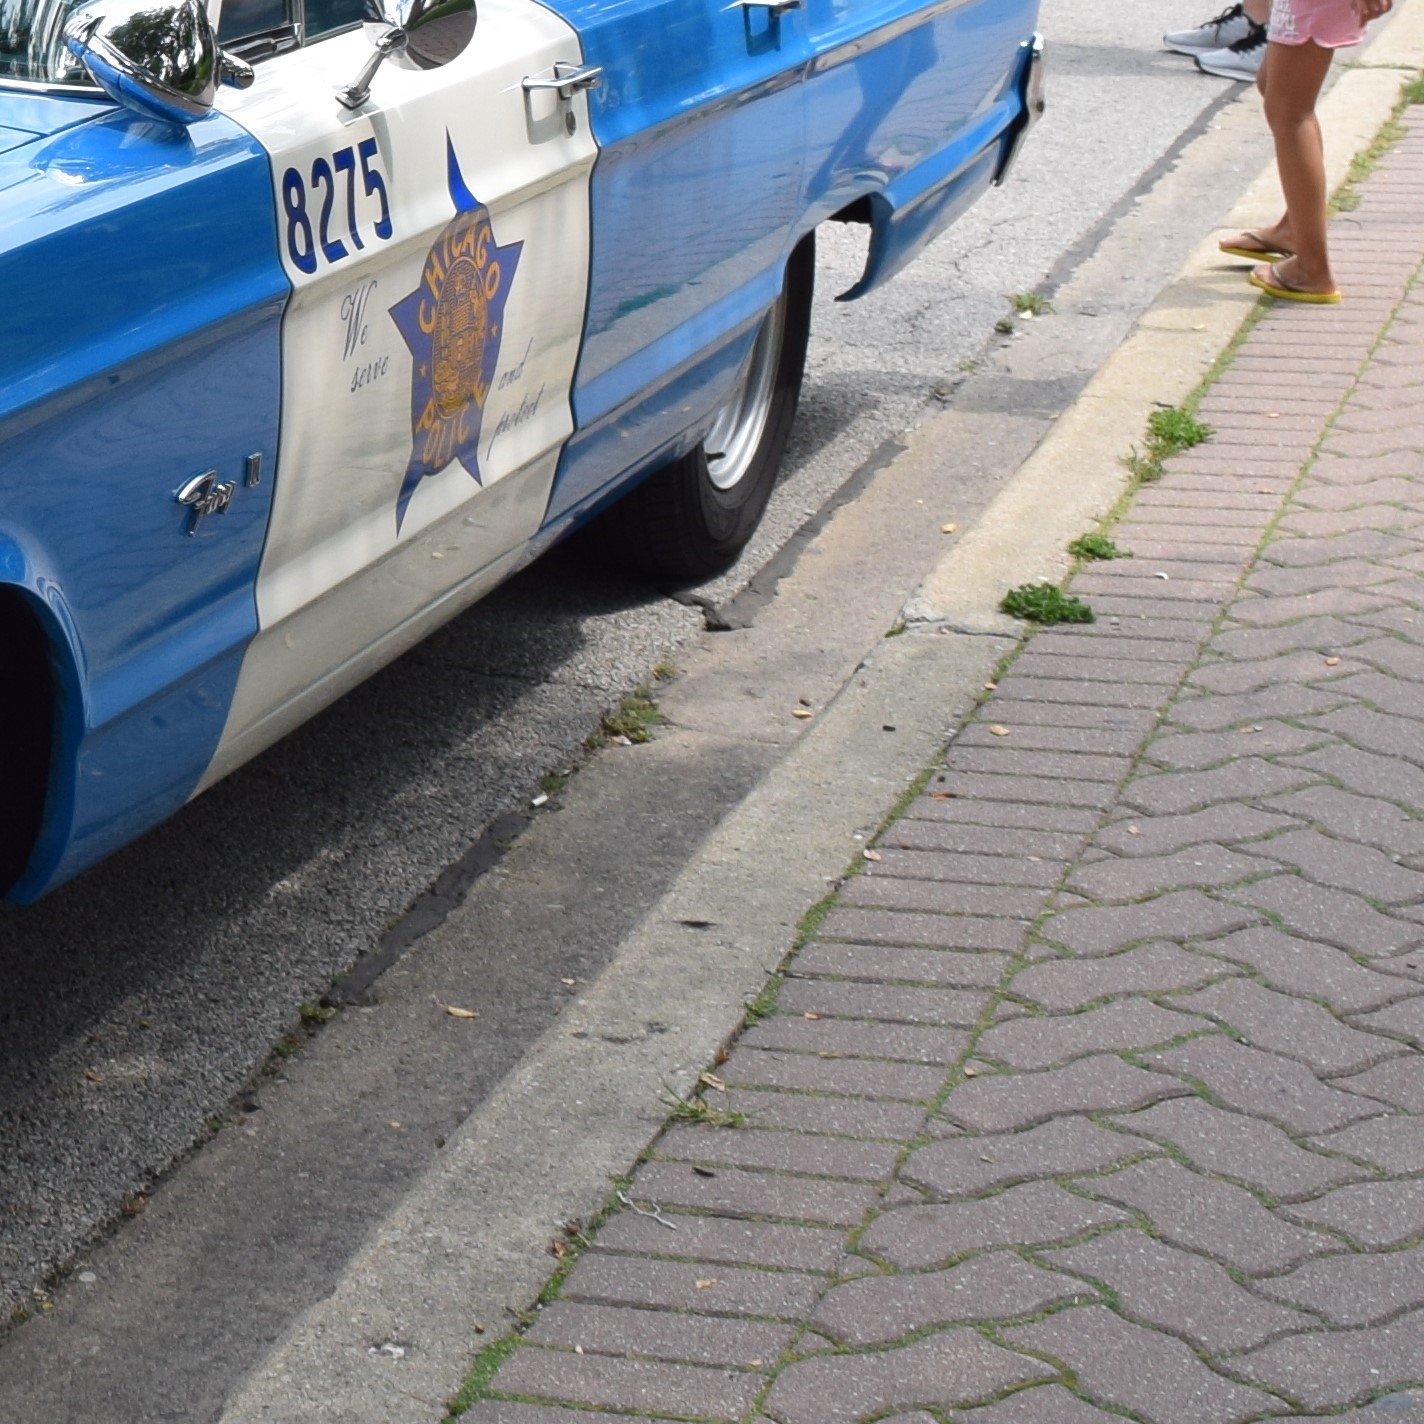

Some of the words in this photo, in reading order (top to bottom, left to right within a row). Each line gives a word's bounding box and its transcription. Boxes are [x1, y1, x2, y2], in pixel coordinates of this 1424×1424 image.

[282, 136, 393, 276] 8275
[418, 222, 501, 335] CHICAGO
[340, 279, 378, 361] We
[350, 355, 389, 393] serve
[498, 336, 534, 391] and
[415, 369, 488, 469] POLICE
[485, 382, 546, 462] protect
